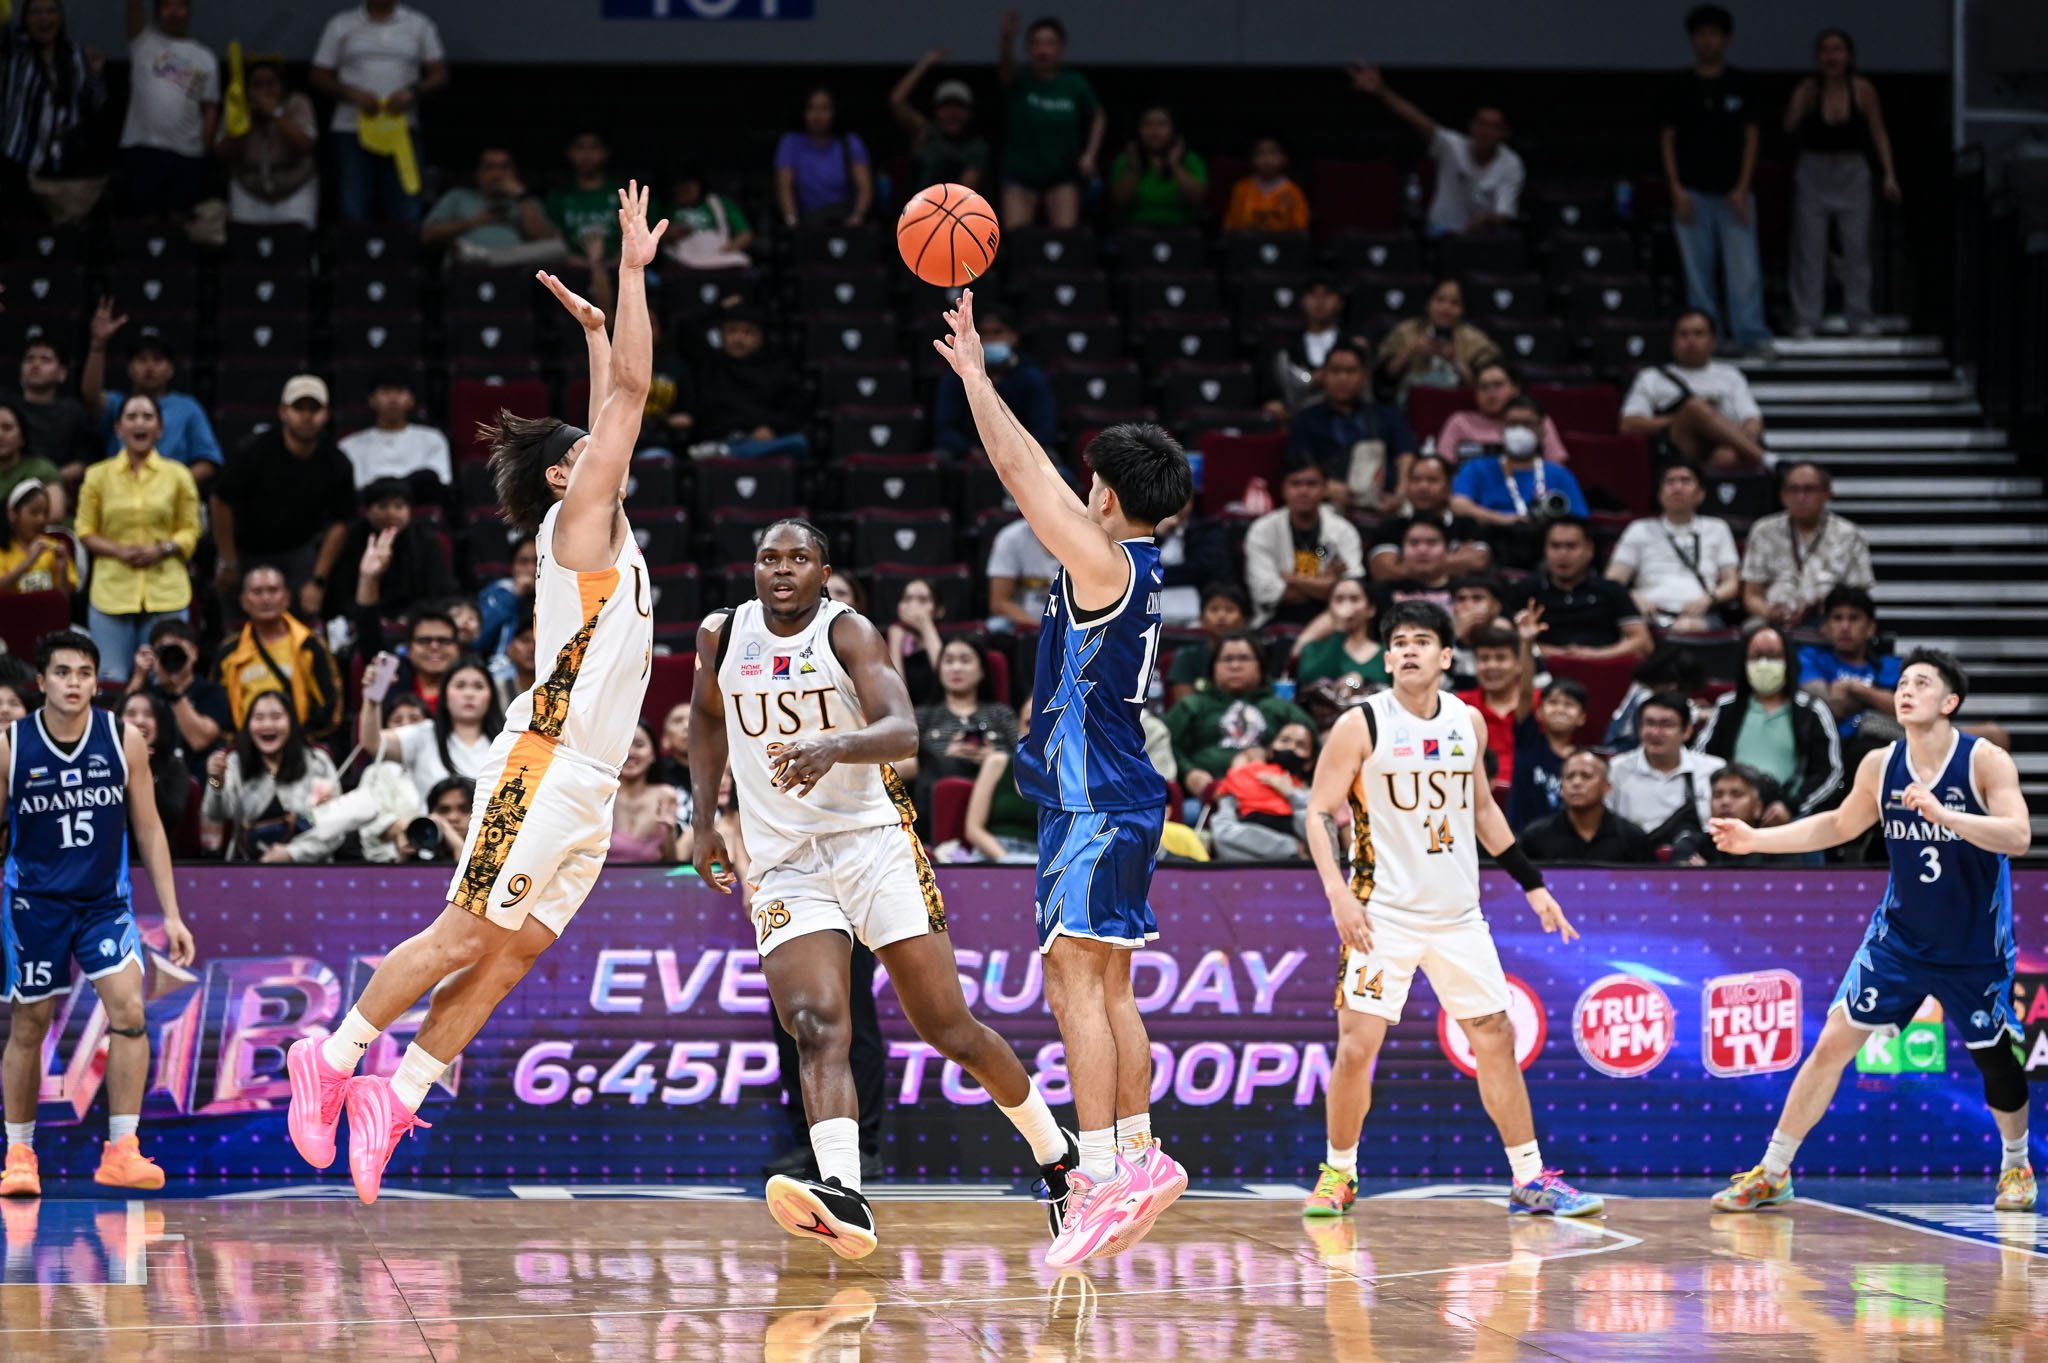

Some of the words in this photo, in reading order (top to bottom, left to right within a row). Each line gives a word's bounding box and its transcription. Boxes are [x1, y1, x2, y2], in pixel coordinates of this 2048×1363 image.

[1123, 621, 1162, 704] 1
[731, 686, 837, 738] UST
[18, 784, 124, 815] ADAMSON
[1381, 769, 1474, 812] UST
[56, 810, 95, 849] 15
[1423, 814, 1455, 855] 14
[1884, 819, 1963, 842] ADAMS
[1919, 845, 1942, 884] 3
[500, 872, 532, 908] 9
[757, 900, 791, 945] 28
[22, 960, 53, 987] 15
[952, 949, 1309, 1015] SUDAY
[1353, 965, 1384, 1000] 14
[1583, 992, 1664, 1029] TRUE
[1708, 999, 1797, 1038] TRUE
[1855, 986, 1879, 1013] 3
[1608, 1020, 1664, 1060] FM
[1723, 1029, 1780, 1069] TV
[513, 1040, 790, 1106] 6:45P
